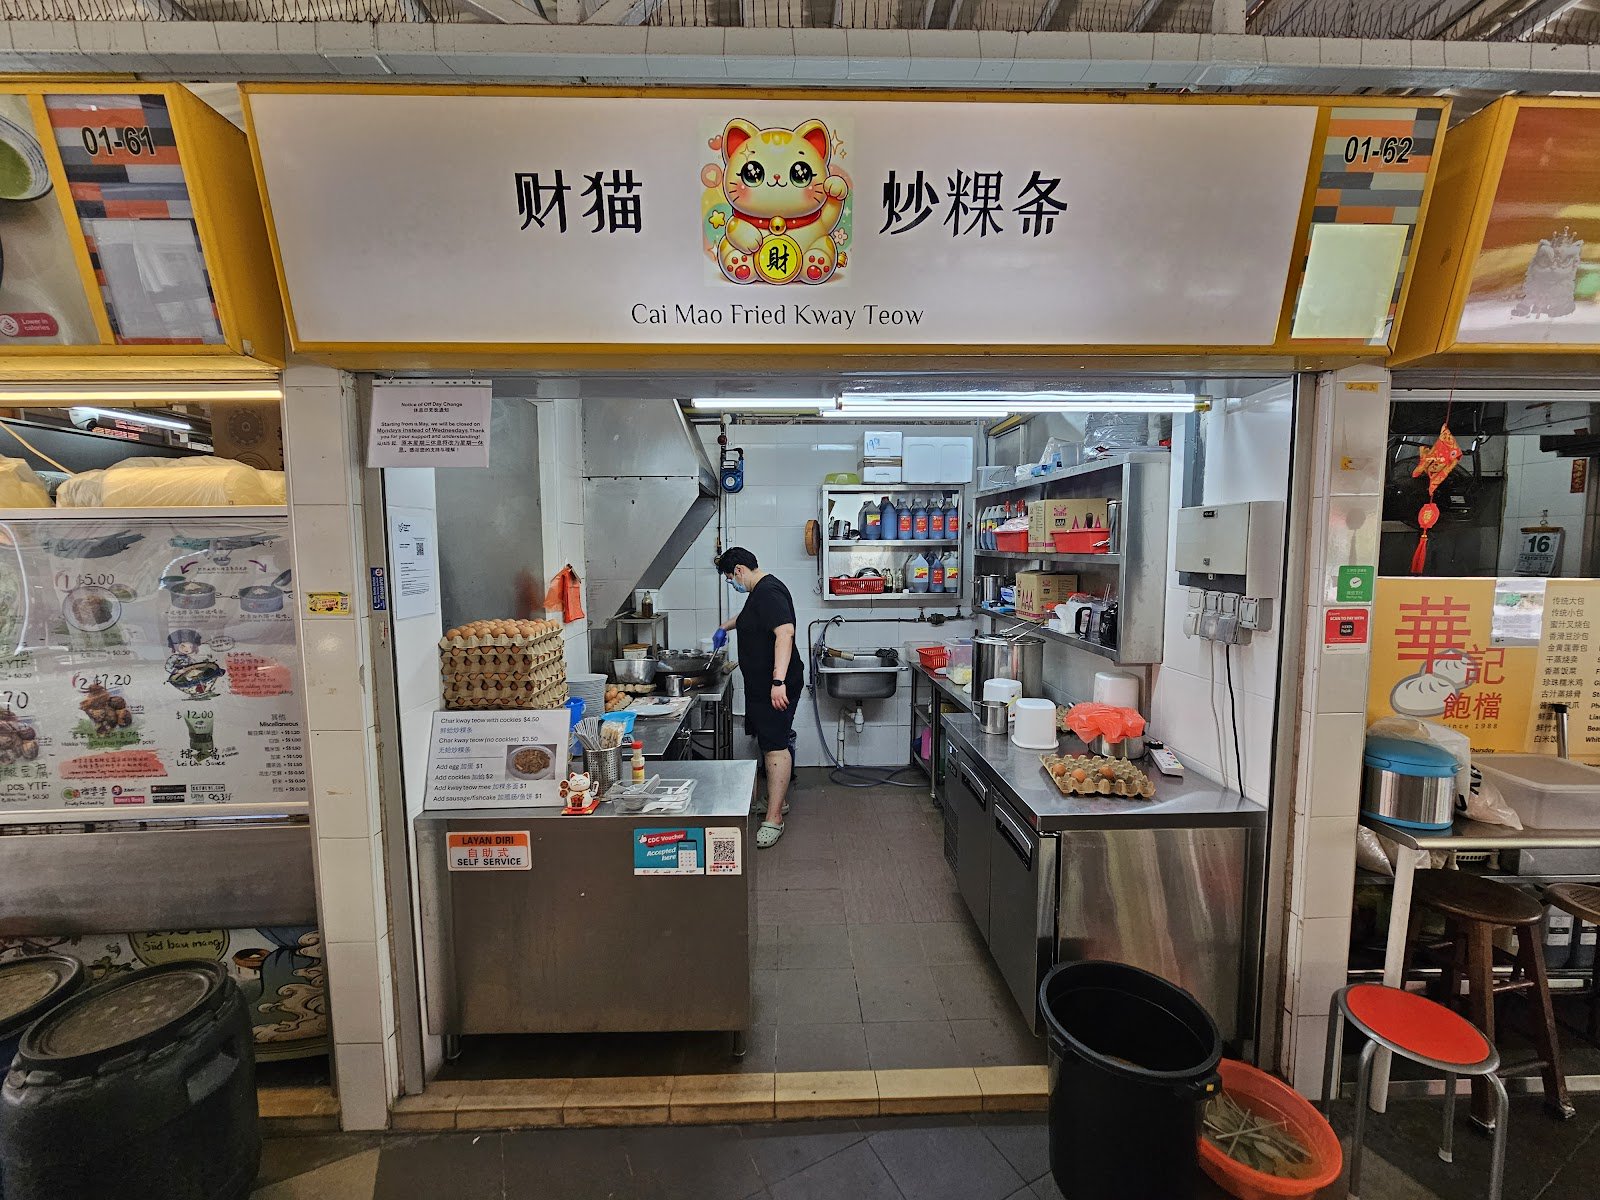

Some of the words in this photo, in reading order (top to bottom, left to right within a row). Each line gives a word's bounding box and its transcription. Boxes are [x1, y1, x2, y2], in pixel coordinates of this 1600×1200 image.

[81, 126, 156, 156] 01-61
[1343, 136, 1414, 165] 01-62
[513, 169, 643, 234] 财猫
[878, 168, 1069, 238] 炒粿条
[766, 246, 789, 272] 財
[631, 304, 667, 326] Cai
[674, 304, 723, 326] Mao
[730, 303, 786, 326] Fried
[794, 304, 857, 331] Kway
[863, 304, 924, 326] Teow
[1528, 535, 1551, 553] 16
[1443, 692, 1503, 721] 飽檔
[187, 710, 213, 719] 12.00
[7, 783, 25, 792] pcs
[446, 794, 496, 802] sausage/fishcake
[462, 836, 492, 845] LAYAN
[495, 836, 514, 844] DIRI
[661, 833, 684, 842] Voucher
[468, 847, 509, 858] 自助式
[646, 846, 677, 857] Accepted
[457, 858, 478, 866] SELF
[483, 858, 521, 866] SERVICE
